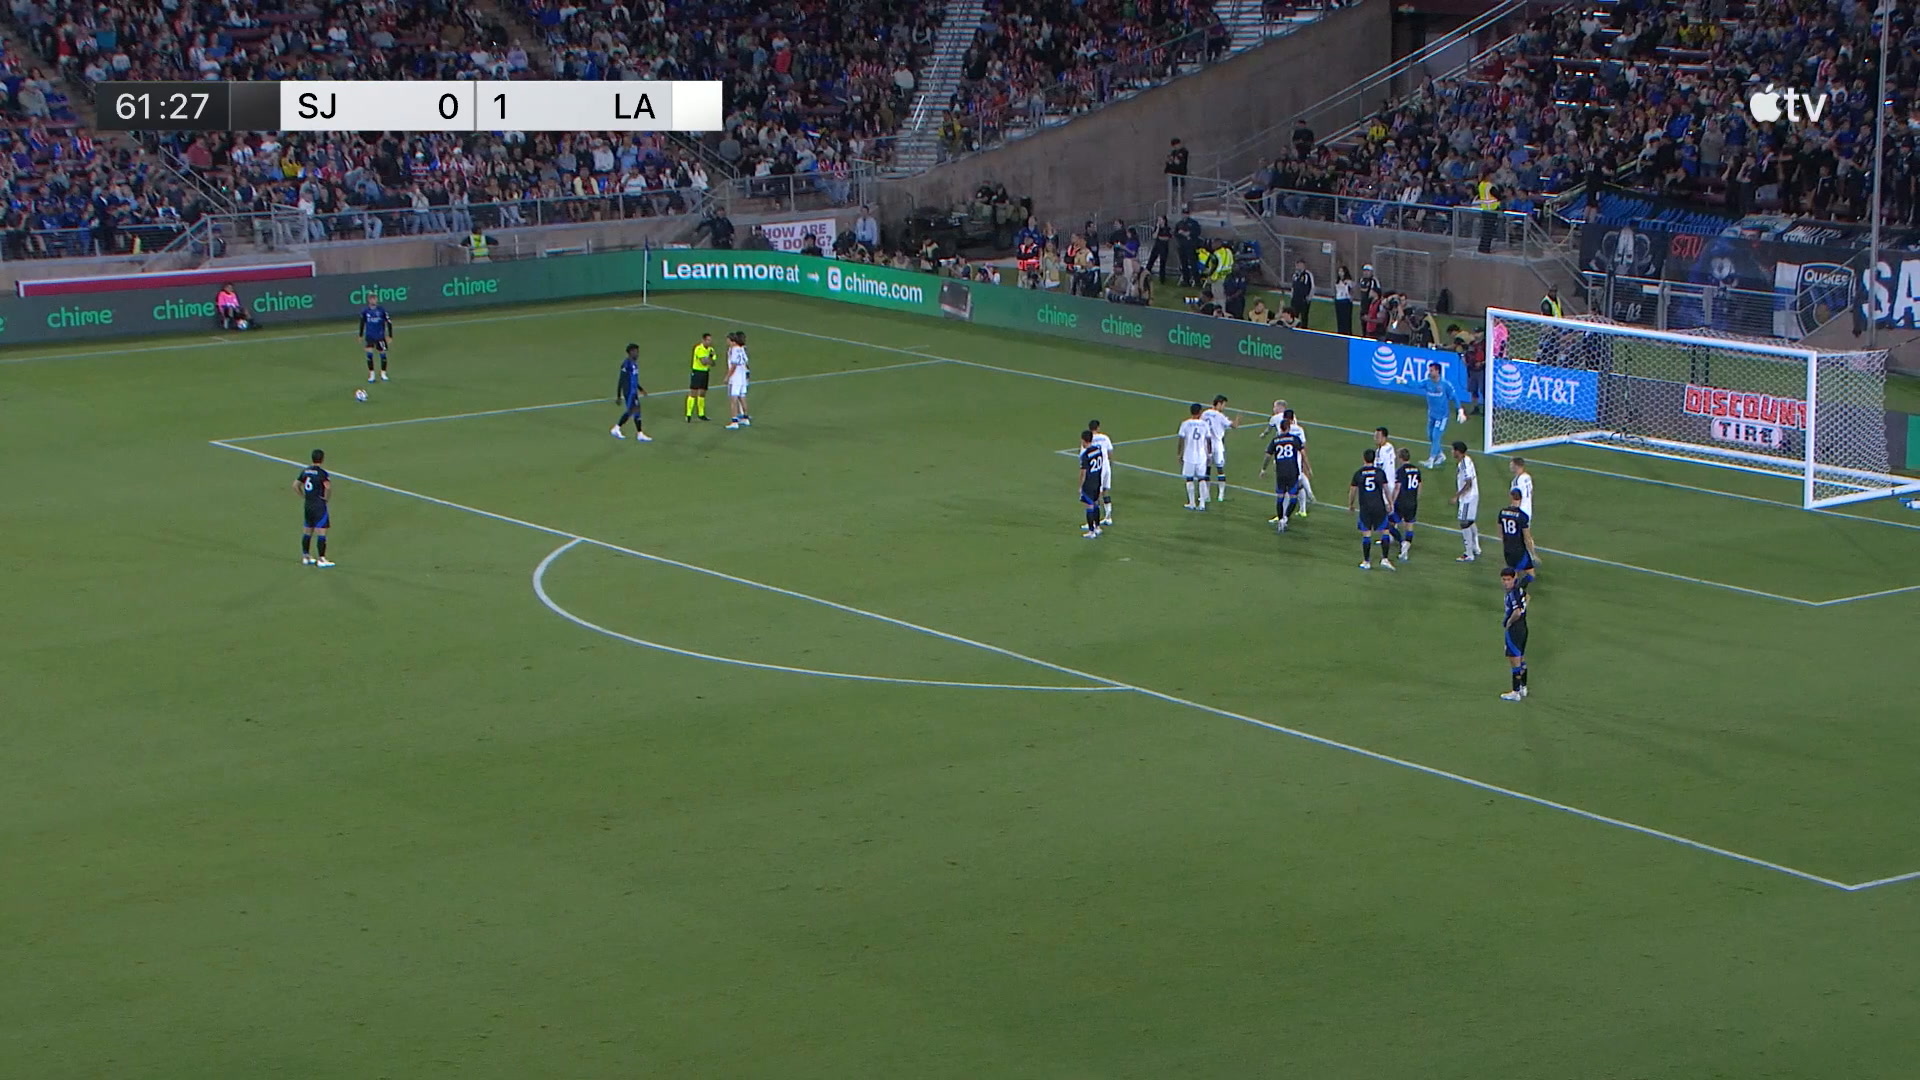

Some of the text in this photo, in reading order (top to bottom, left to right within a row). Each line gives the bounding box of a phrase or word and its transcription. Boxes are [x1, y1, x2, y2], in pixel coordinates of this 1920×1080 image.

[764, 226, 795, 239] HOW
[783, 235, 832, 250] DOG?
[442, 277, 498, 297] chime
[663, 260, 728, 279] Learn
[734, 263, 784, 281] more
[786, 264, 799, 283] at
[845, 272, 923, 303] chime.com
[153, 299, 216, 320] chime
[253, 291, 314, 313] chime
[47, 306, 113, 328] chime
[1036, 304, 1077, 328] chime
[1101, 314, 1143, 338] chime
[1168, 324, 1212, 349] chime
[1238, 335, 1283, 360] chime
[1527, 375, 1580, 404] AT&T
[1193, 427, 1201, 440] 6
[1718, 421, 1774, 444] TIRE
[1276, 444, 1293, 459] 28
[1090, 456, 1103, 473] 20
[304, 477, 313, 491] 6
[1365, 477, 1376, 492] 5
[1407, 474, 1418, 489] 16
[1501, 518, 1516, 534] 18
